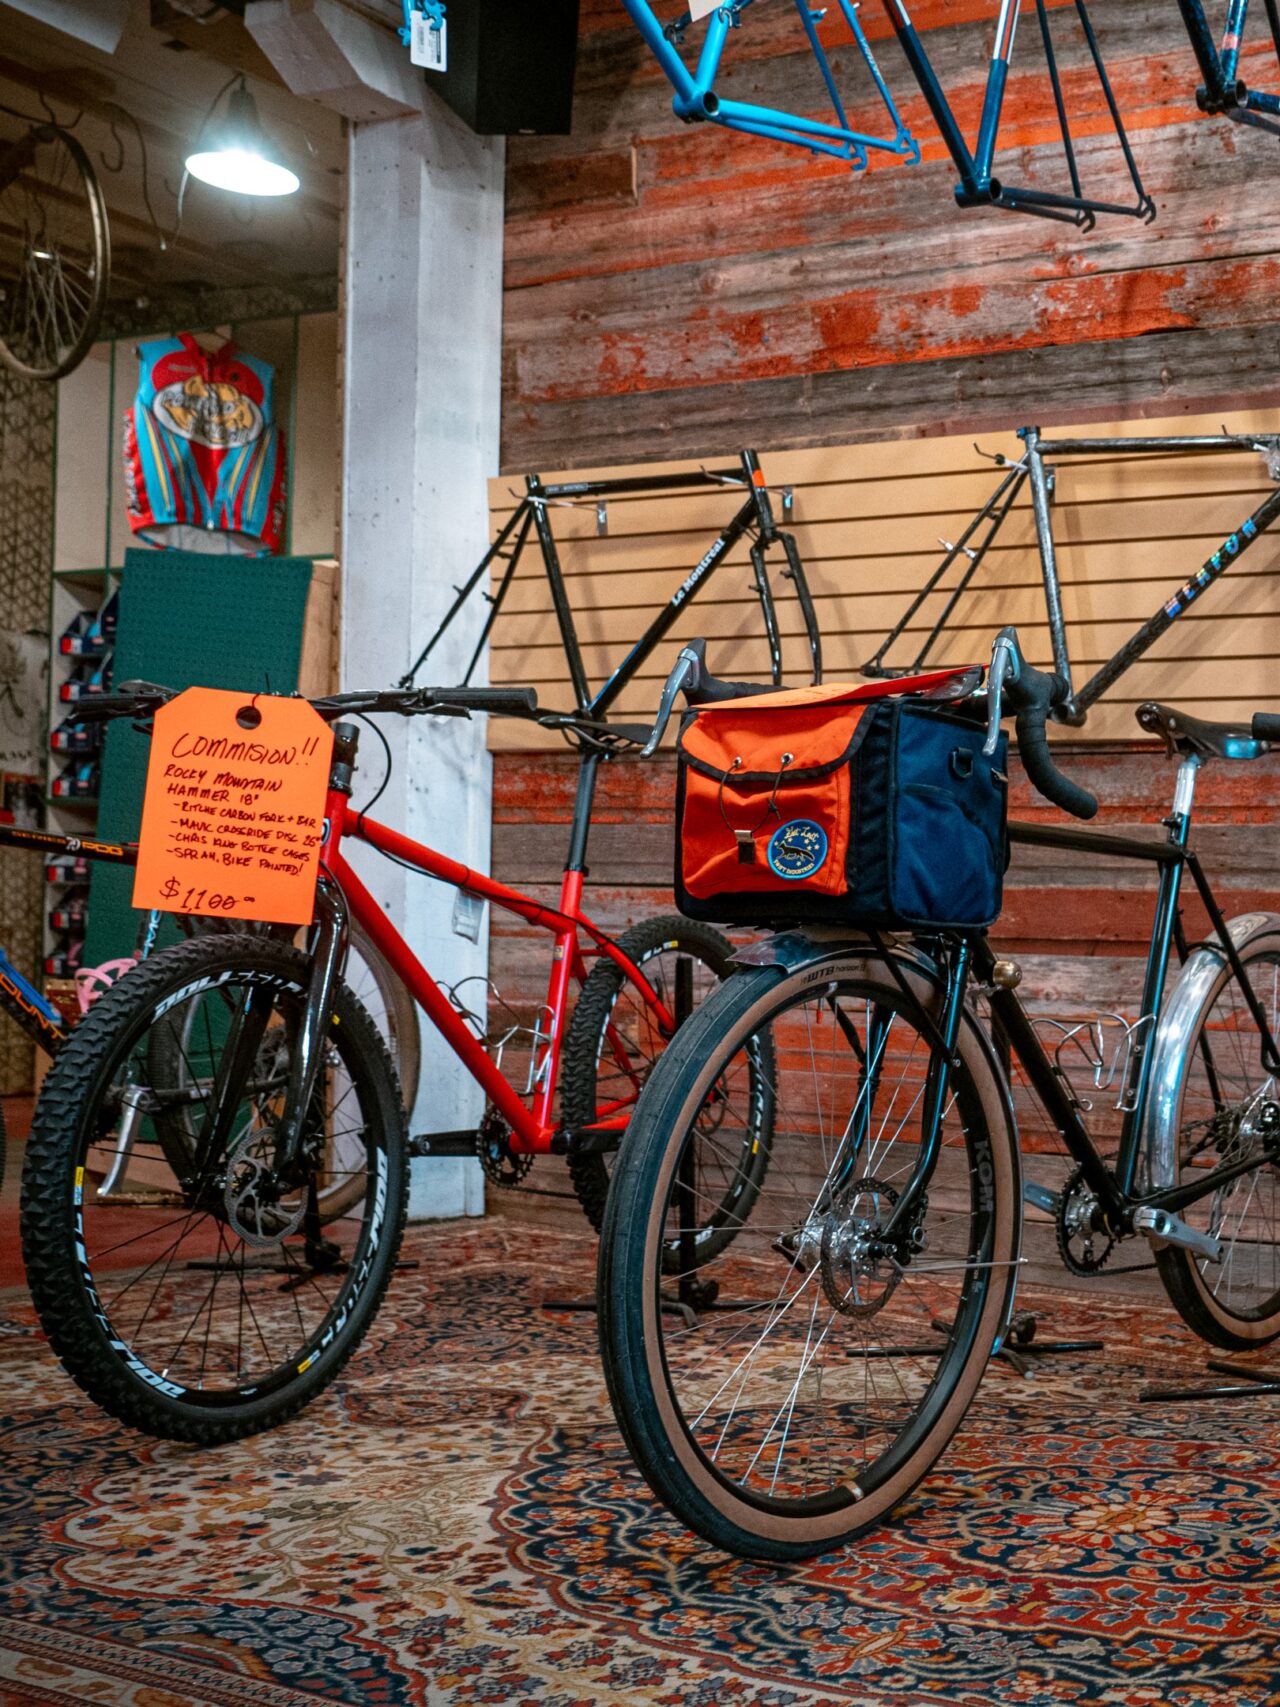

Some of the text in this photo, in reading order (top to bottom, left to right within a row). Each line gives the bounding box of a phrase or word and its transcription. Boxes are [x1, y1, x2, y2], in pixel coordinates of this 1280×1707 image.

[671, 589, 686, 607] Le
[163, 763, 283, 792] ROCKY MOUNTAIN
[167, 782, 231, 803] HAMMER
[219, 807, 256, 823] CARBON
[259, 811, 285, 824] FORK
[296, 815, 317, 829] BAR
[216, 822, 274, 840] CROSSRIDE
[276, 829, 298, 843] DISC
[212, 836, 239, 850] KING
[241, 841, 278, 856] BOTTLE
[282, 847, 311, 863] CAGES
[807, 965, 836, 982] WTB
[973, 1139, 994, 1212] KOM
